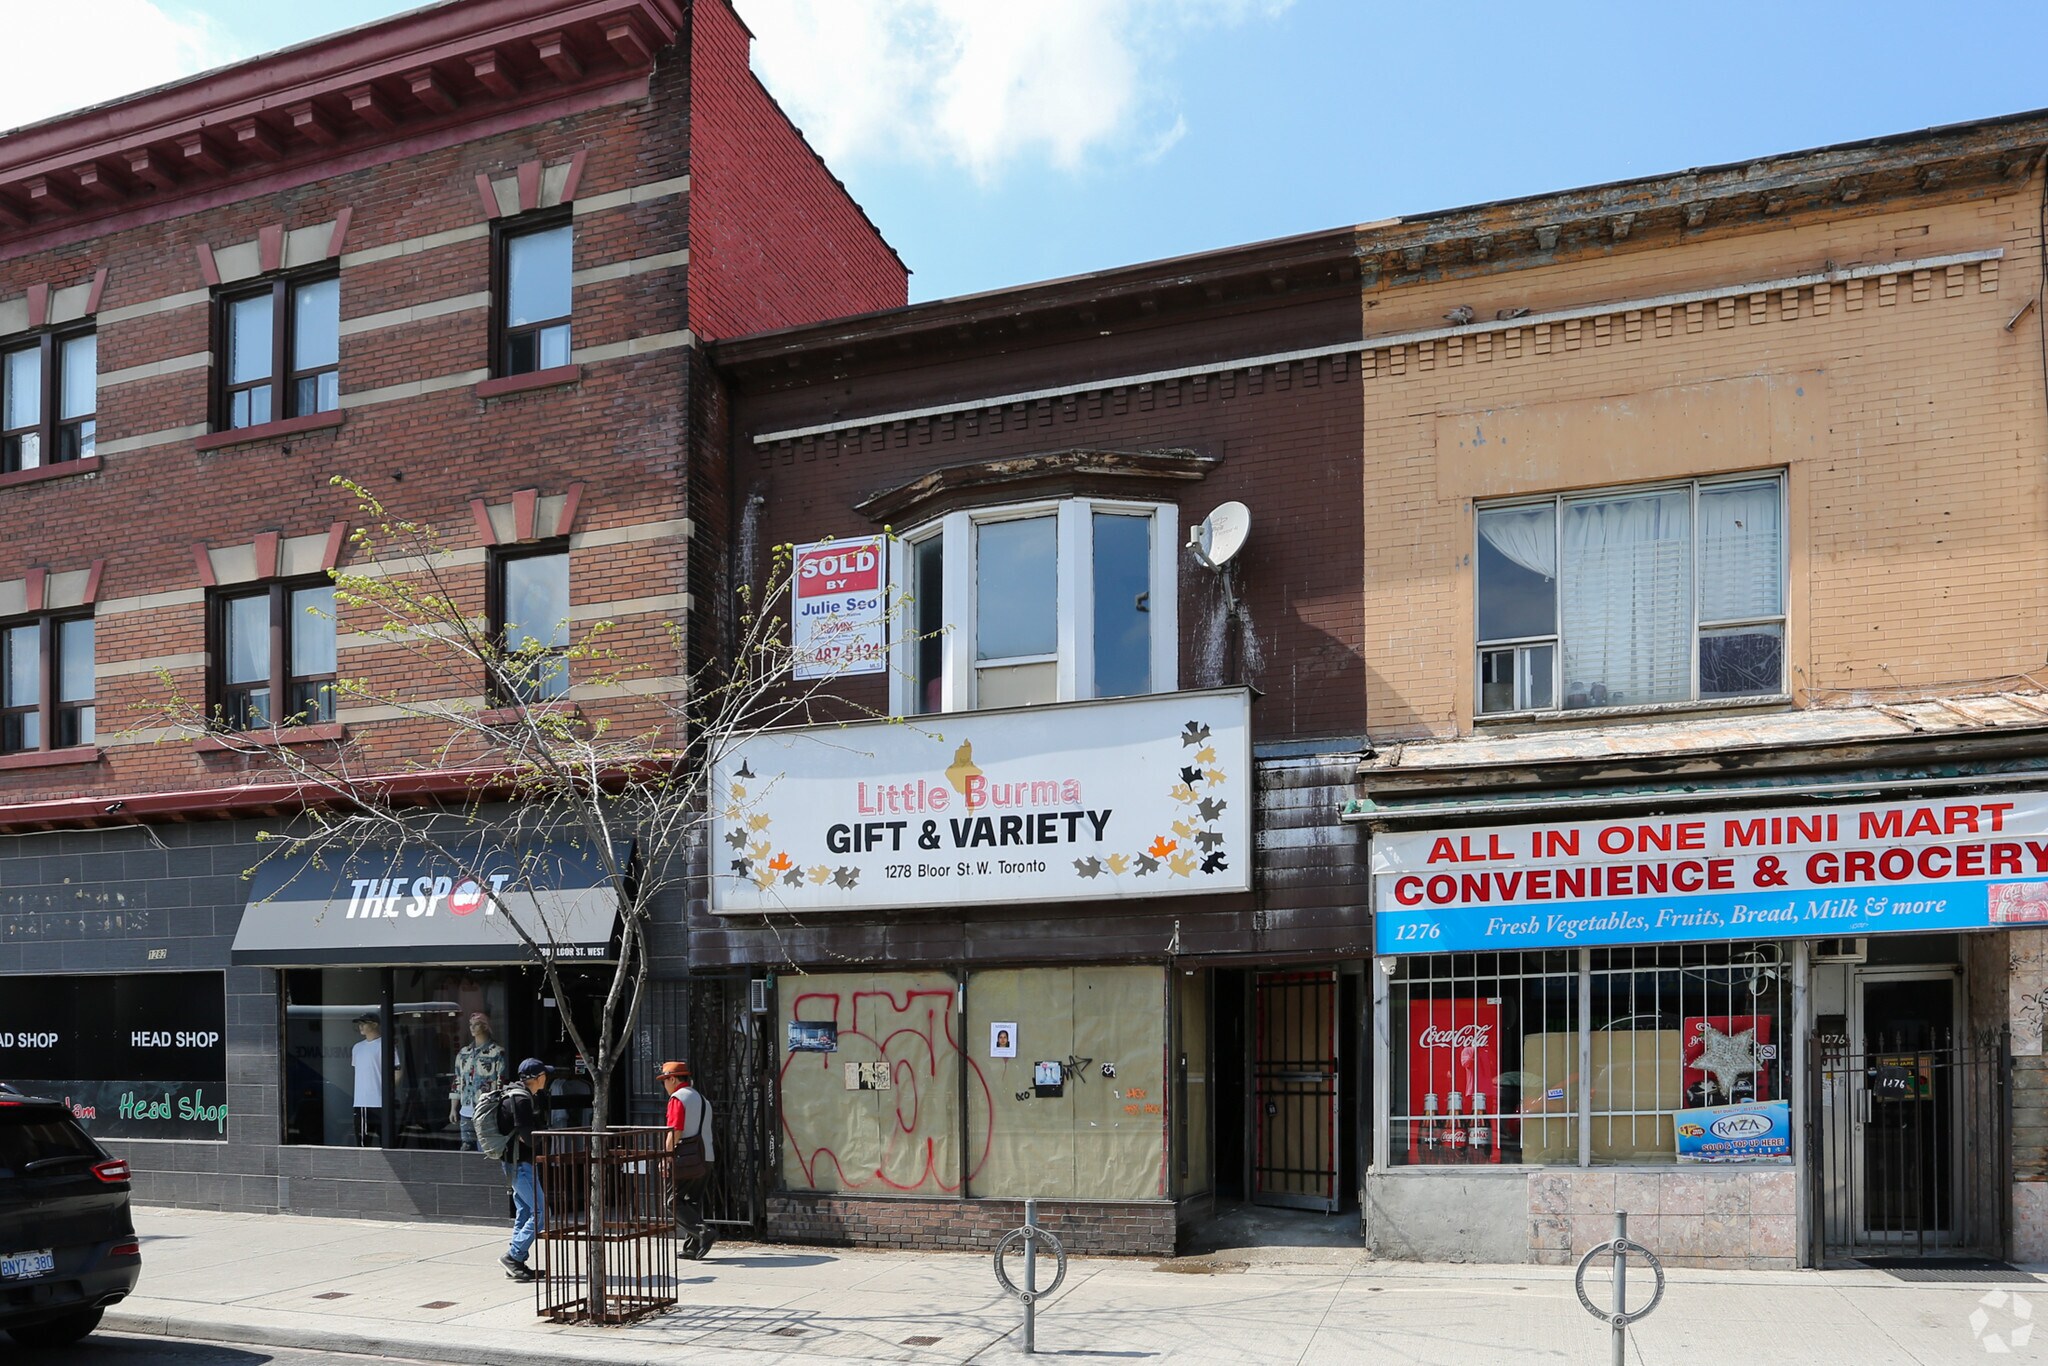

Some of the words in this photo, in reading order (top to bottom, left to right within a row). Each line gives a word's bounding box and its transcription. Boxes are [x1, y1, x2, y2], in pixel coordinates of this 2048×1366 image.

[801, 552, 875, 579] SOLD
[826, 579, 848, 590] BY
[801, 601, 841, 616] Julie
[857, 780, 950, 816] Little
[965, 775, 1083, 809] Burma
[826, 821, 907, 853] GIFT
[918, 820, 941, 850] &
[950, 809, 1112, 848] VARIETY
[1426, 834, 1515, 864] ALL
[1532, 829, 1580, 858] IN
[1597, 822, 1706, 854] ONE
[1724, 813, 1838, 847] MINI
[1859, 803, 2014, 840] MART
[885, 865, 912, 879] 1278
[918, 863, 950, 877] Bloor
[998, 860, 1046, 874] Toronto
[1394, 858, 1735, 906] CONVENIENCE
[1753, 855, 1789, 888] &
[1805, 841, 2048, 884] GROCERY
[345, 877, 409, 919] THE
[1485, 915, 1540, 937] Fresh
[1546, 910, 1650, 939] Vegetables,
[1655, 907, 1725, 929] Fruits,
[1729, 902, 1799, 925] Bread,
[1803, 898, 1858, 920] Milk
[1864, 896, 1889, 917] &
[1891, 898, 1947, 916] more
[1394, 923, 1440, 941] 1276
[576, 948, 586, 956] ST.
[587, 947, 605, 956] WEST
[18, 1032, 59, 1048] SHOP
[131, 1031, 172, 1047] HEAD
[175, 1031, 220, 1048] SHOP
[1821, 1035, 1846, 1045] 1276
[119, 1091, 172, 1120] Head
[178, 1088, 229, 1134] Shop
[1717, 1119, 1760, 1135] RAZA
[1702, 1142, 1723, 1151] SOLD
[1733, 1140, 1748, 1149] TOP
[1749, 1139, 1759, 1148] UP
[1761, 1137, 1785, 1147] HERE!
[2, 1258, 28, 1275] BNYZ
[33, 1254, 53, 1270] 380
